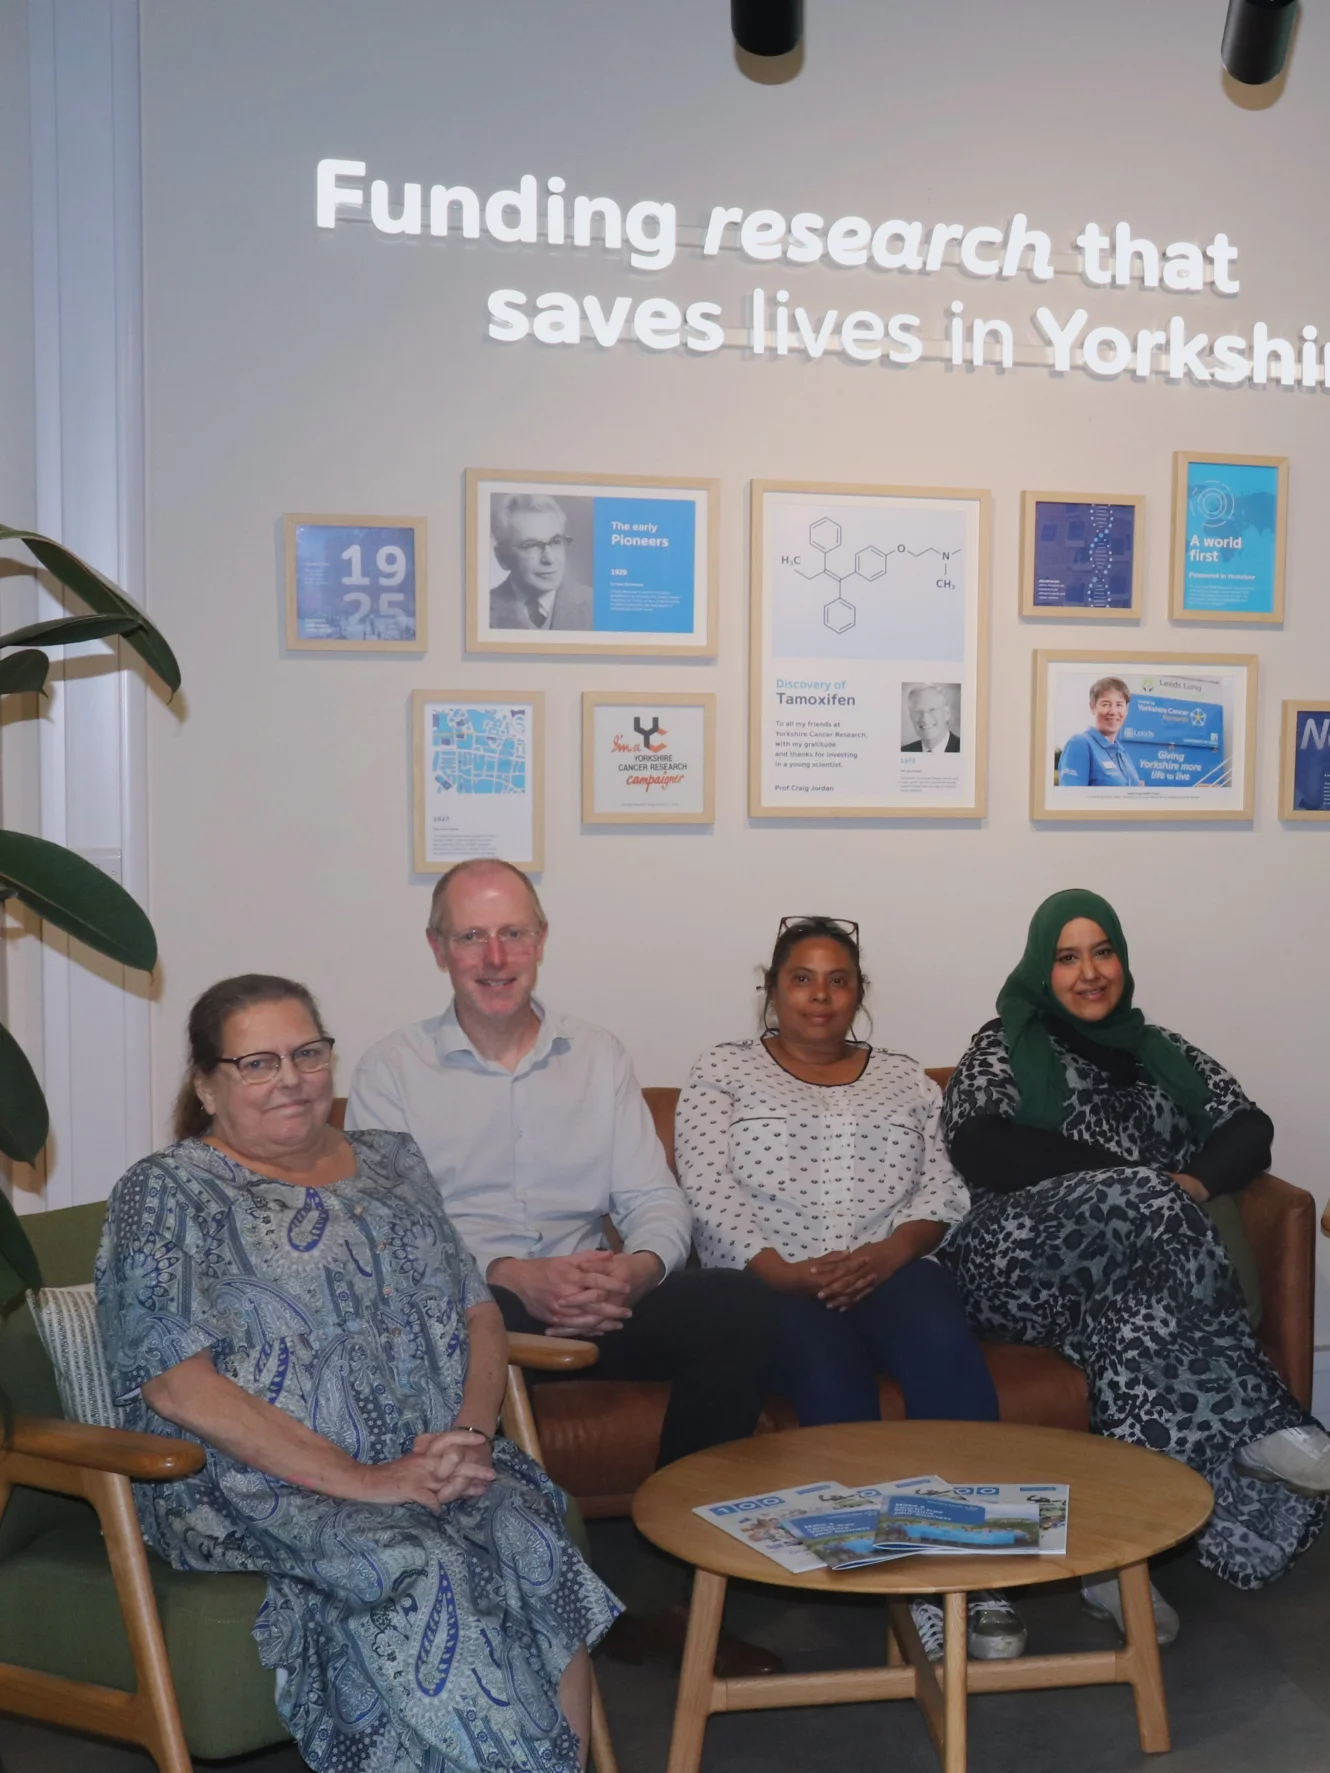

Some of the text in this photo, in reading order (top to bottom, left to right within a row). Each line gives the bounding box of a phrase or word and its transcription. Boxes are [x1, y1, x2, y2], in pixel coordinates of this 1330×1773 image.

[316, 158, 1240, 295] Funding research that
[486, 289, 725, 353] saves
[752, 288, 923, 364] lives
[950, 300, 1014, 369] in
[611, 521, 658, 534] The early
[611, 534, 669, 547] Pioneers
[1190, 534, 1243, 549] A world
[897, 544, 906, 553] O
[942, 552, 950, 561] N
[1189, 549, 1219, 562] first
[341, 544, 407, 586] 19
[342, 591, 409, 632] 25
[776, 679, 847, 691] Discovery of
[1159, 679, 1182, 690] Leeds
[1183, 683, 1202, 693] Lung
[776, 692, 856, 706] Tamoxifen
[786, 720, 794, 728] all
[808, 720, 832, 728] friends
[776, 730, 808, 738] Yorkshire
[835, 731, 869, 739] Research,
[633, 743, 641, 752] a
[775, 740, 836, 749] with my gratitude
[634, 754, 673, 763] YORKSHIRE
[775, 750, 858, 760] and thanks for investing
[1158, 750, 1185, 762] Giving
[618, 763, 687, 772] CANCER RESEARCH
[1139, 759, 1202, 772] Yorkshire more
[626, 770, 685, 793] campaigner
[791, 784, 809, 793] Craig
